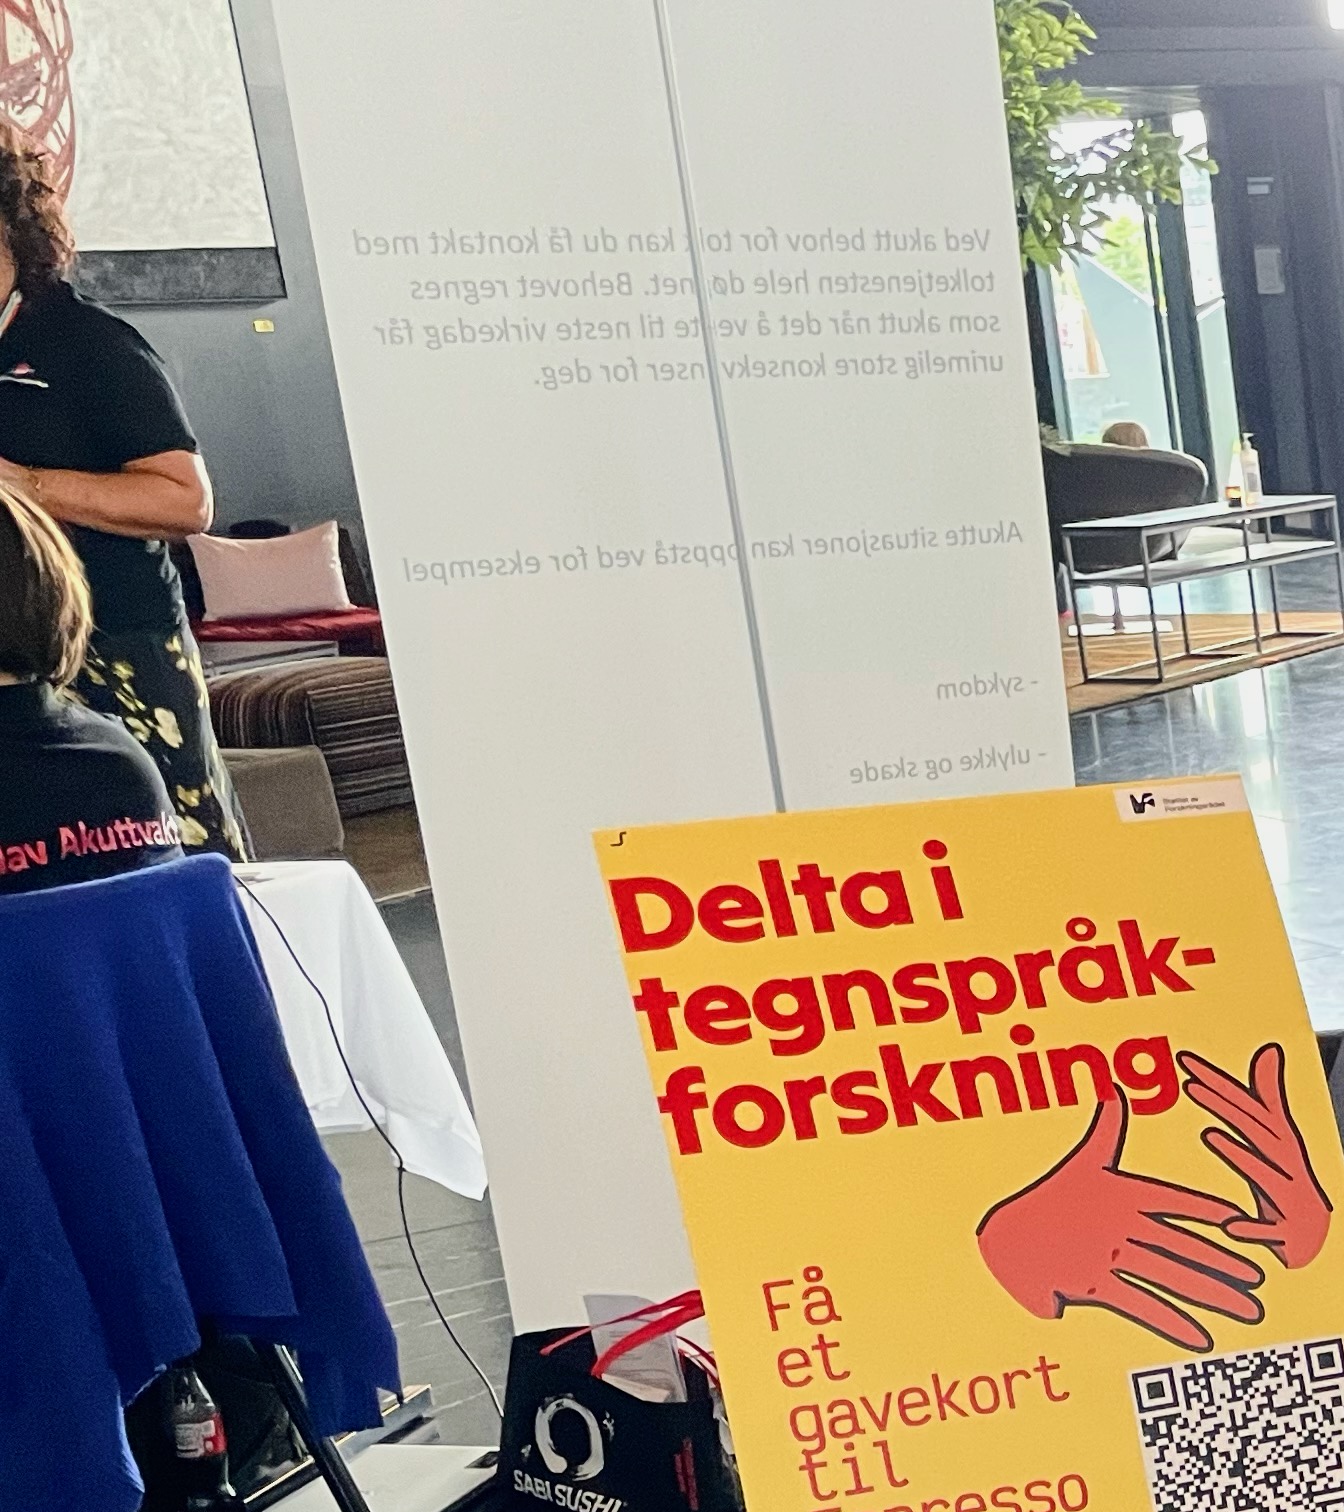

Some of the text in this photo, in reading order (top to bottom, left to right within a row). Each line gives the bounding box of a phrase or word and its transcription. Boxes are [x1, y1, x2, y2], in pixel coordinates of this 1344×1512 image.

[609, 839, 964, 953] Delta i
[633, 917, 1216, 1057] tegnspråk-
[657, 1024, 1180, 1156] forskning
[762, 1265, 842, 1332] Få
[777, 1333, 851, 1388] et
[789, 1356, 1070, 1456] gavekort
[513, 1470, 553, 1502] SABI
[799, 1440, 909, 1501] til
